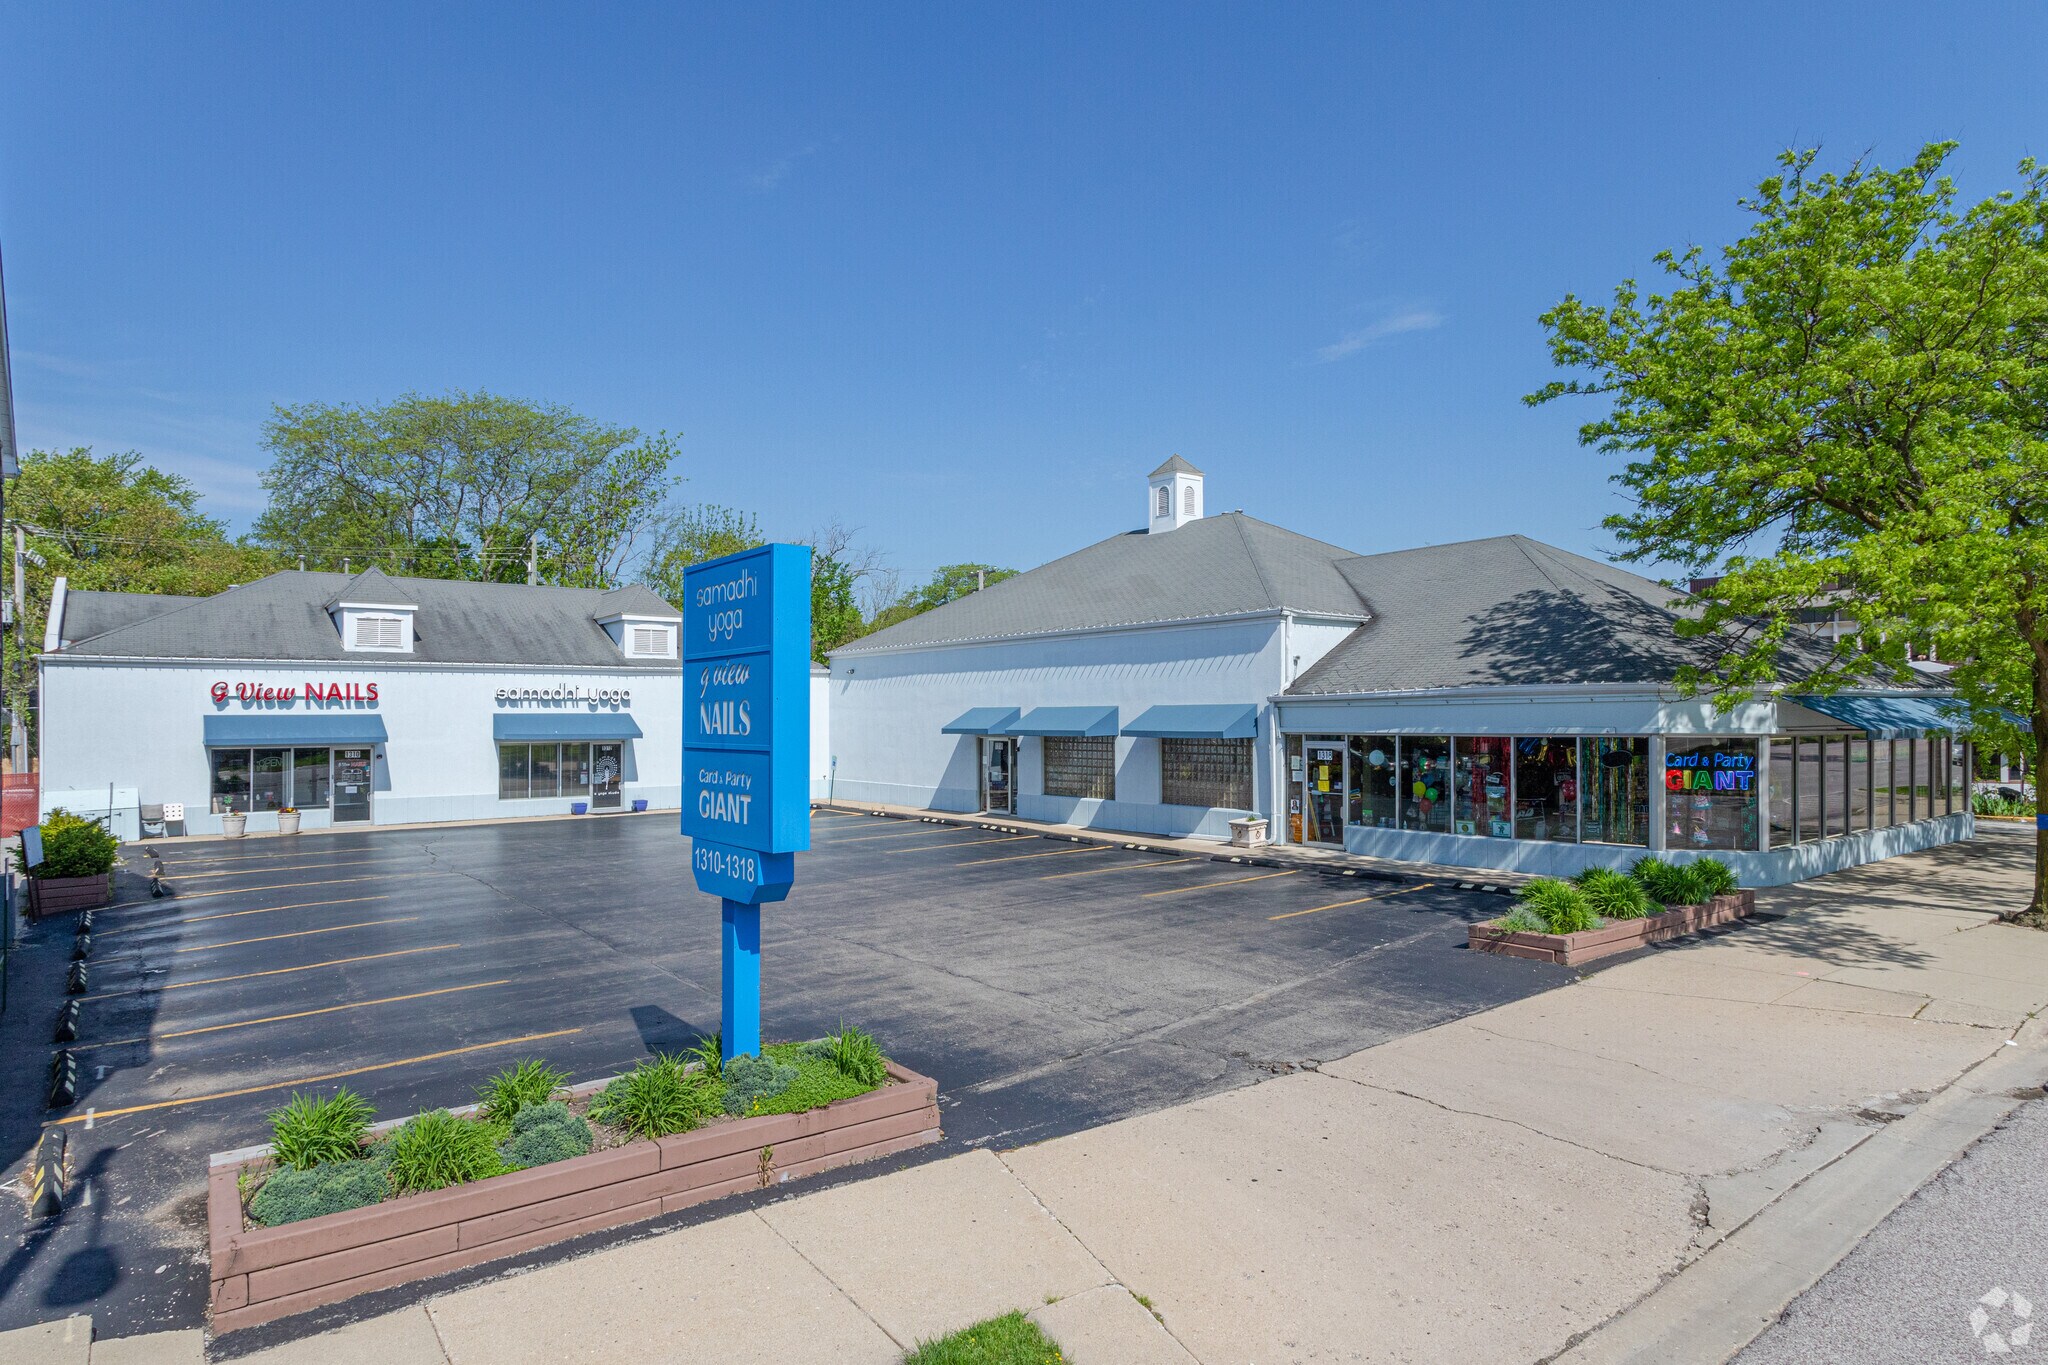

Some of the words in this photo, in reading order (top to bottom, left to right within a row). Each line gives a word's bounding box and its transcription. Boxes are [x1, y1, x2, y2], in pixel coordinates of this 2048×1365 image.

[696, 568, 757, 608] samadhi
[708, 608, 743, 642] yoga
[713, 657, 750, 686] view
[235, 682, 296, 702] View
[305, 682, 379, 702] NAILS
[496, 682, 580, 701] samadhi
[587, 687, 631, 706] yoga
[699, 700, 751, 737] NAILS
[345, 751, 361, 759] 1310
[1666, 752, 1699, 767] Card
[1702, 756, 1710, 766] &
[1714, 752, 1754, 770] Party
[699, 768, 718, 785] Card
[725, 770, 752, 790] Party
[1666, 769, 1754, 791] GIANT
[699, 790, 752, 825] GIANT
[695, 847, 755, 882] 1310-1318
